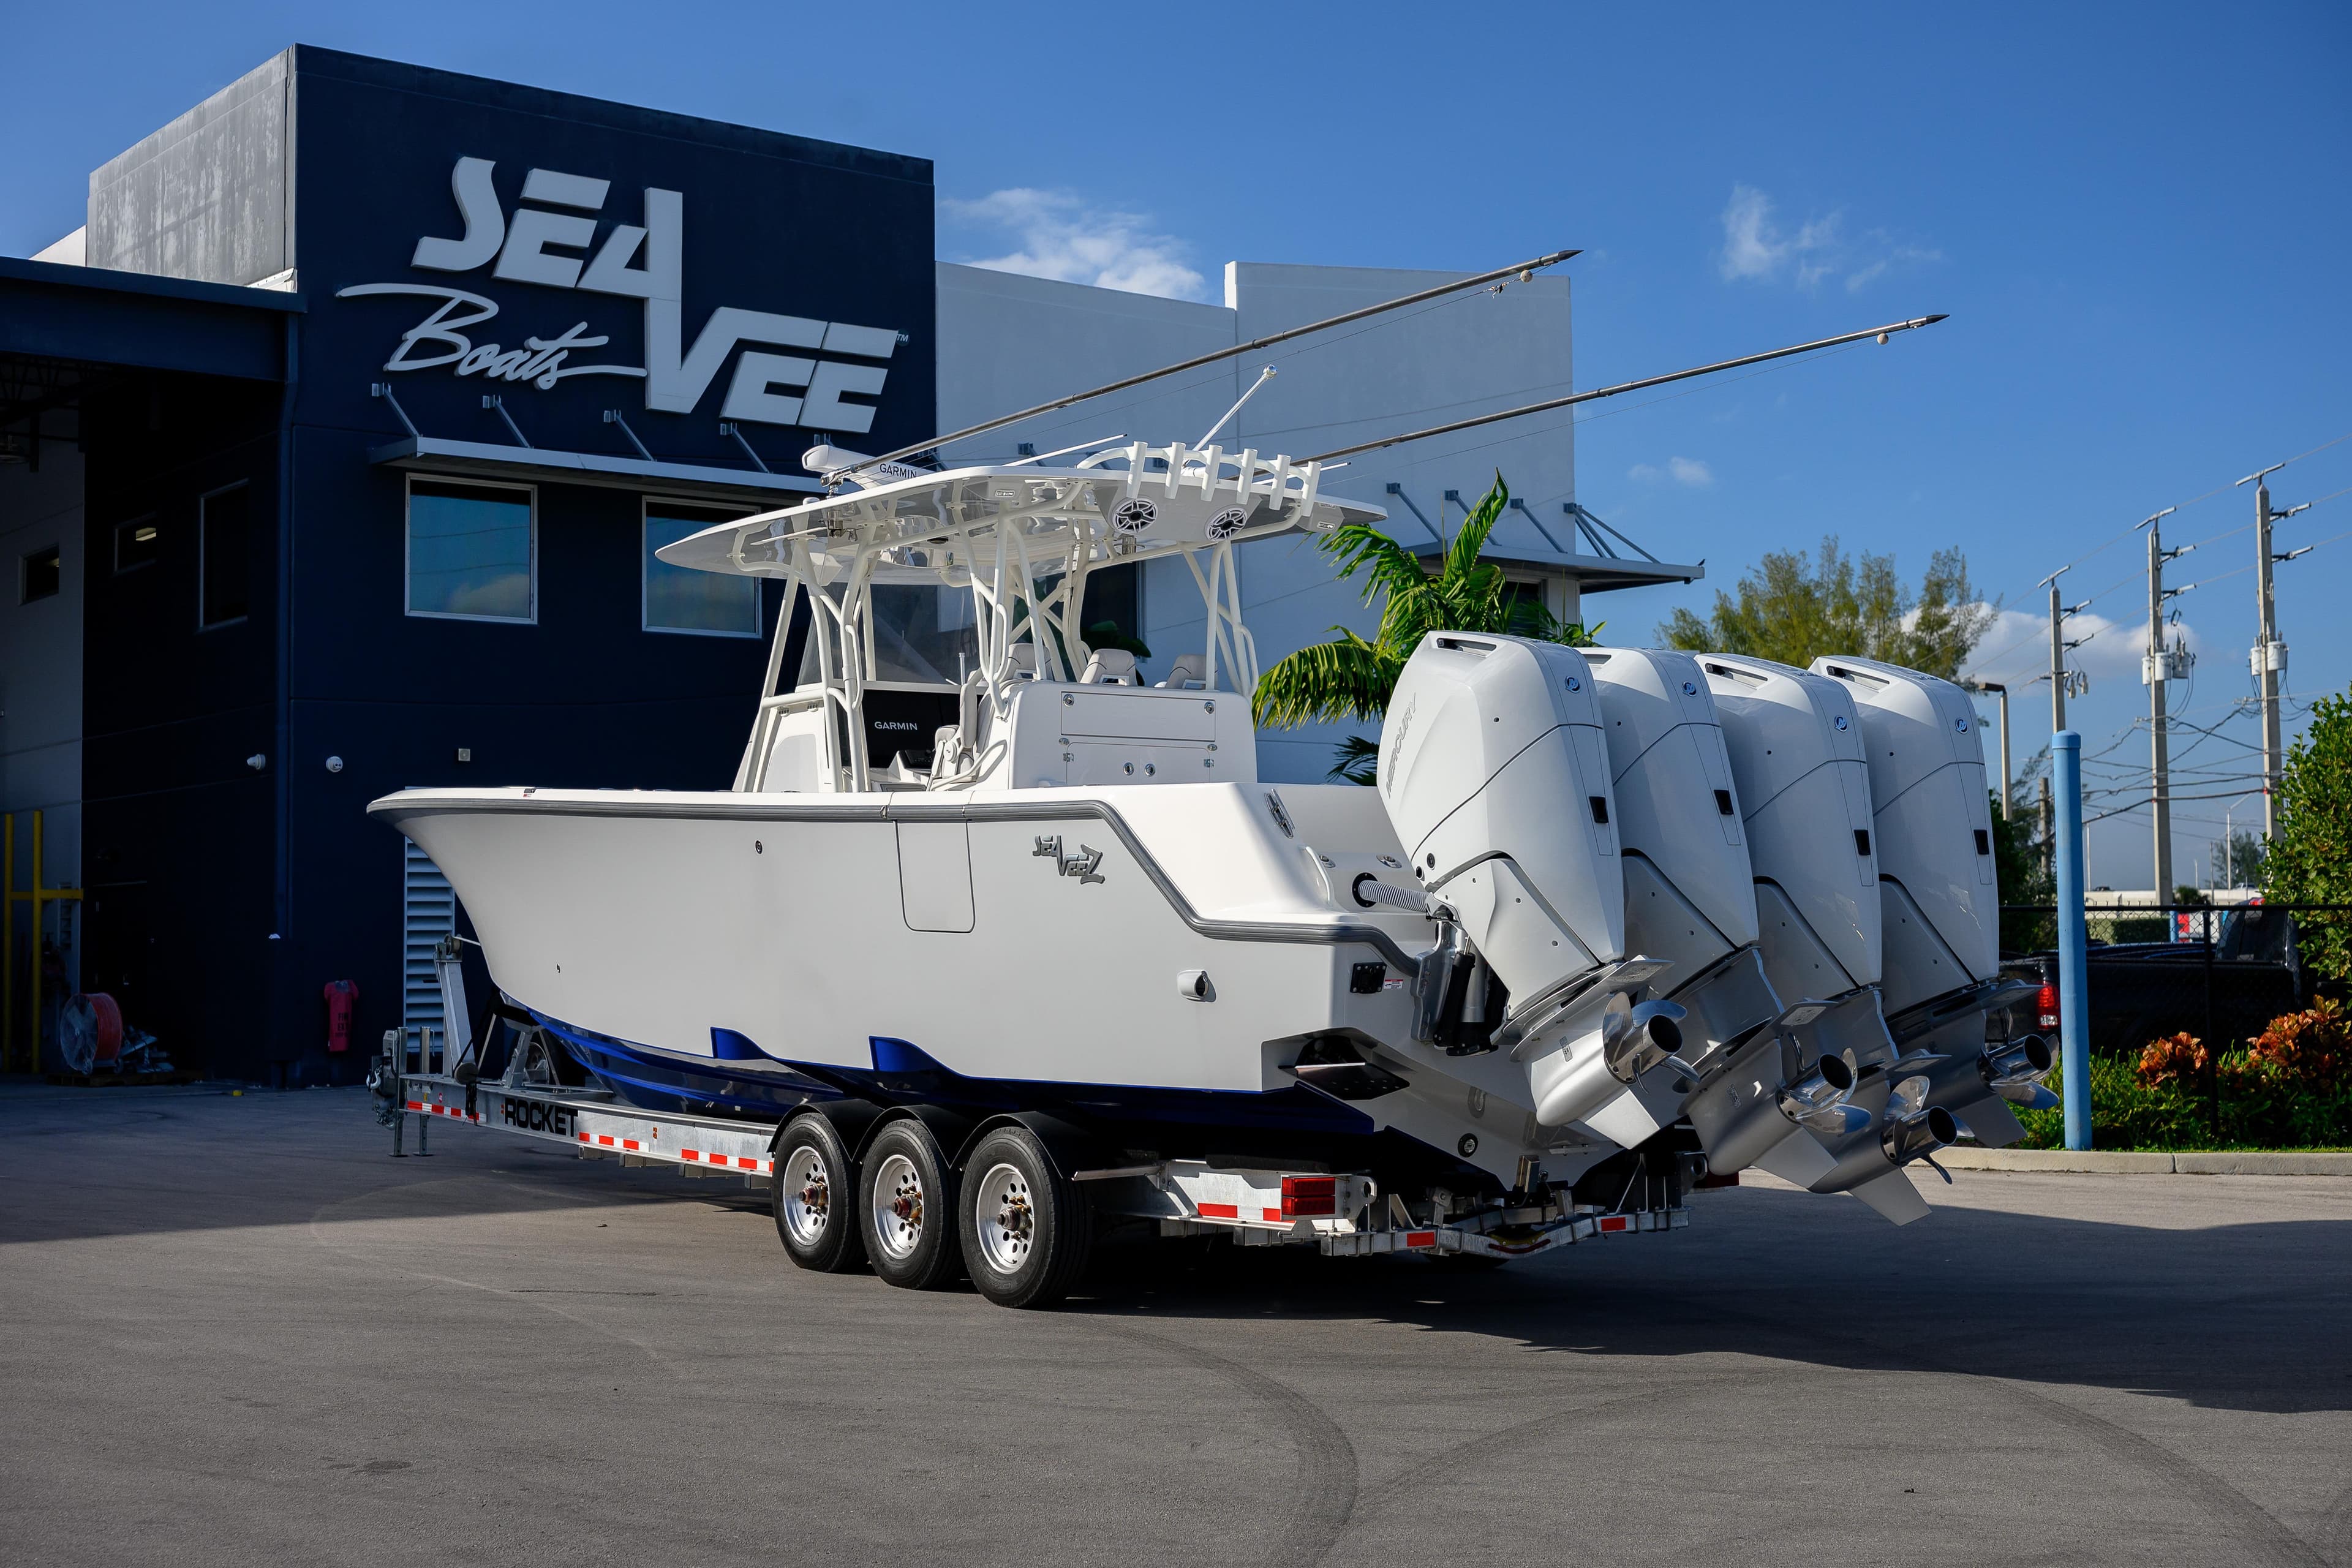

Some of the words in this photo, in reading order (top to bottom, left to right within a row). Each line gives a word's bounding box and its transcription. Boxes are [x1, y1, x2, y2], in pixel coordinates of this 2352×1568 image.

[411, 156, 683, 301] SEA
[336, 282, 648, 390] Boats
[645, 298, 899, 433] VEE
[880, 463, 918, 479] GARMIN
[874, 721, 918, 731] GARMIN
[1385, 692, 1416, 799] MERCURY
[504, 1096, 579, 1137] ROCKET
